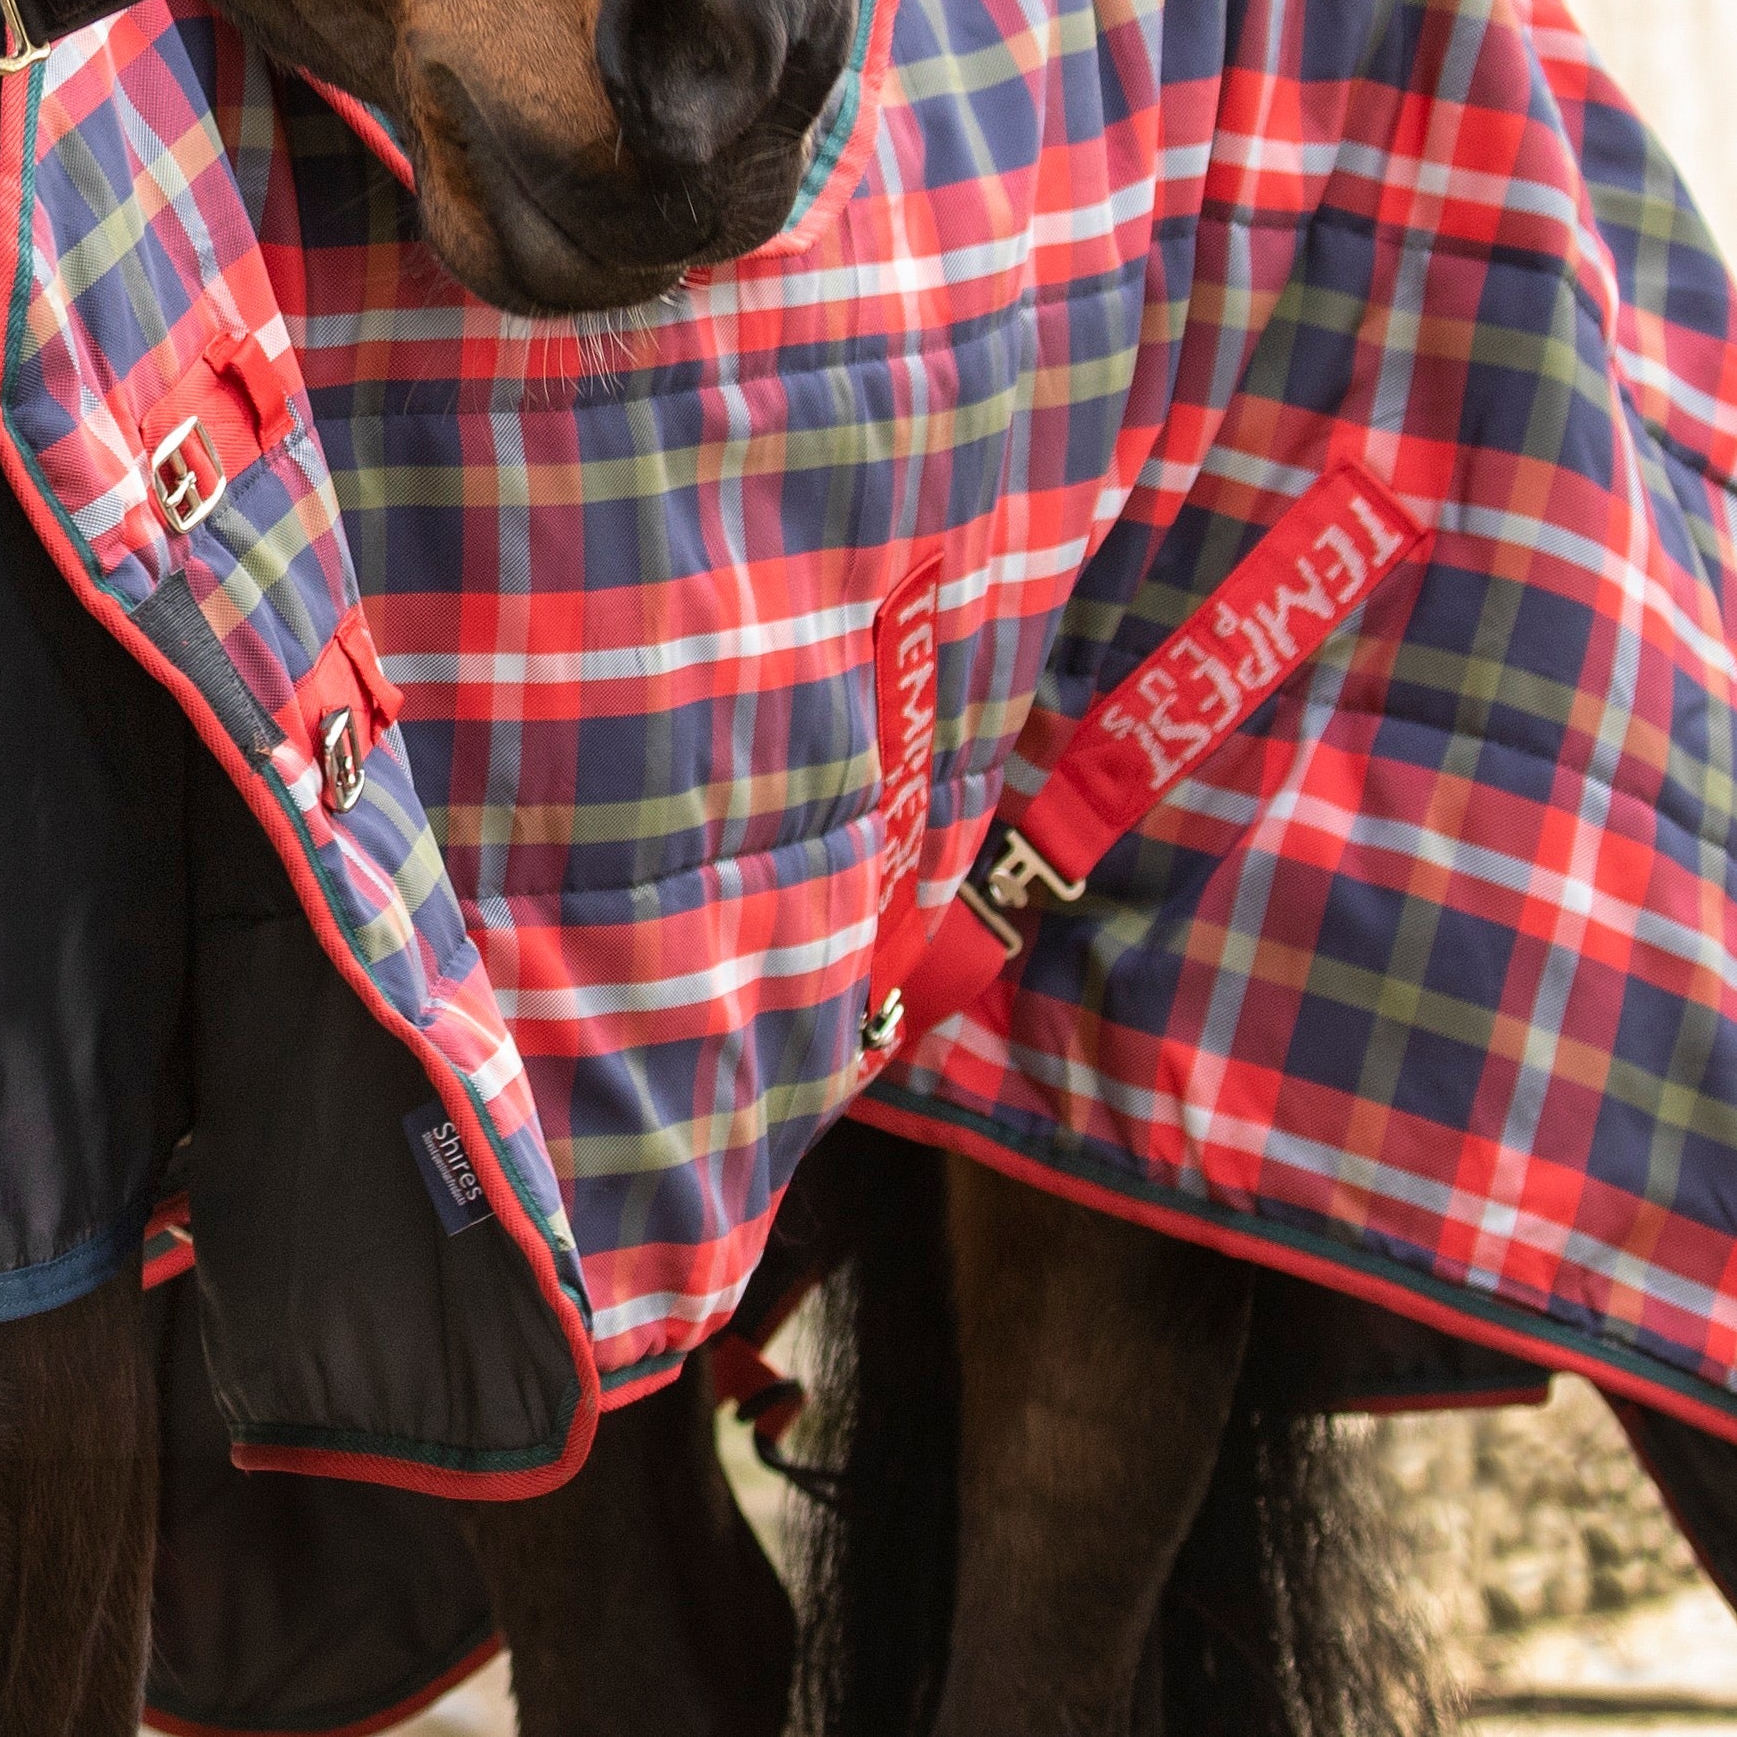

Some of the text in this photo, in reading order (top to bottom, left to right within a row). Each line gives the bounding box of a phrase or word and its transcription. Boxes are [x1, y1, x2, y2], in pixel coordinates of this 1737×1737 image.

[1101, 599, 1245, 742] PLUS
[1125, 496, 1404, 791] TEMPEST
[432, 1122, 483, 1201] Shires
